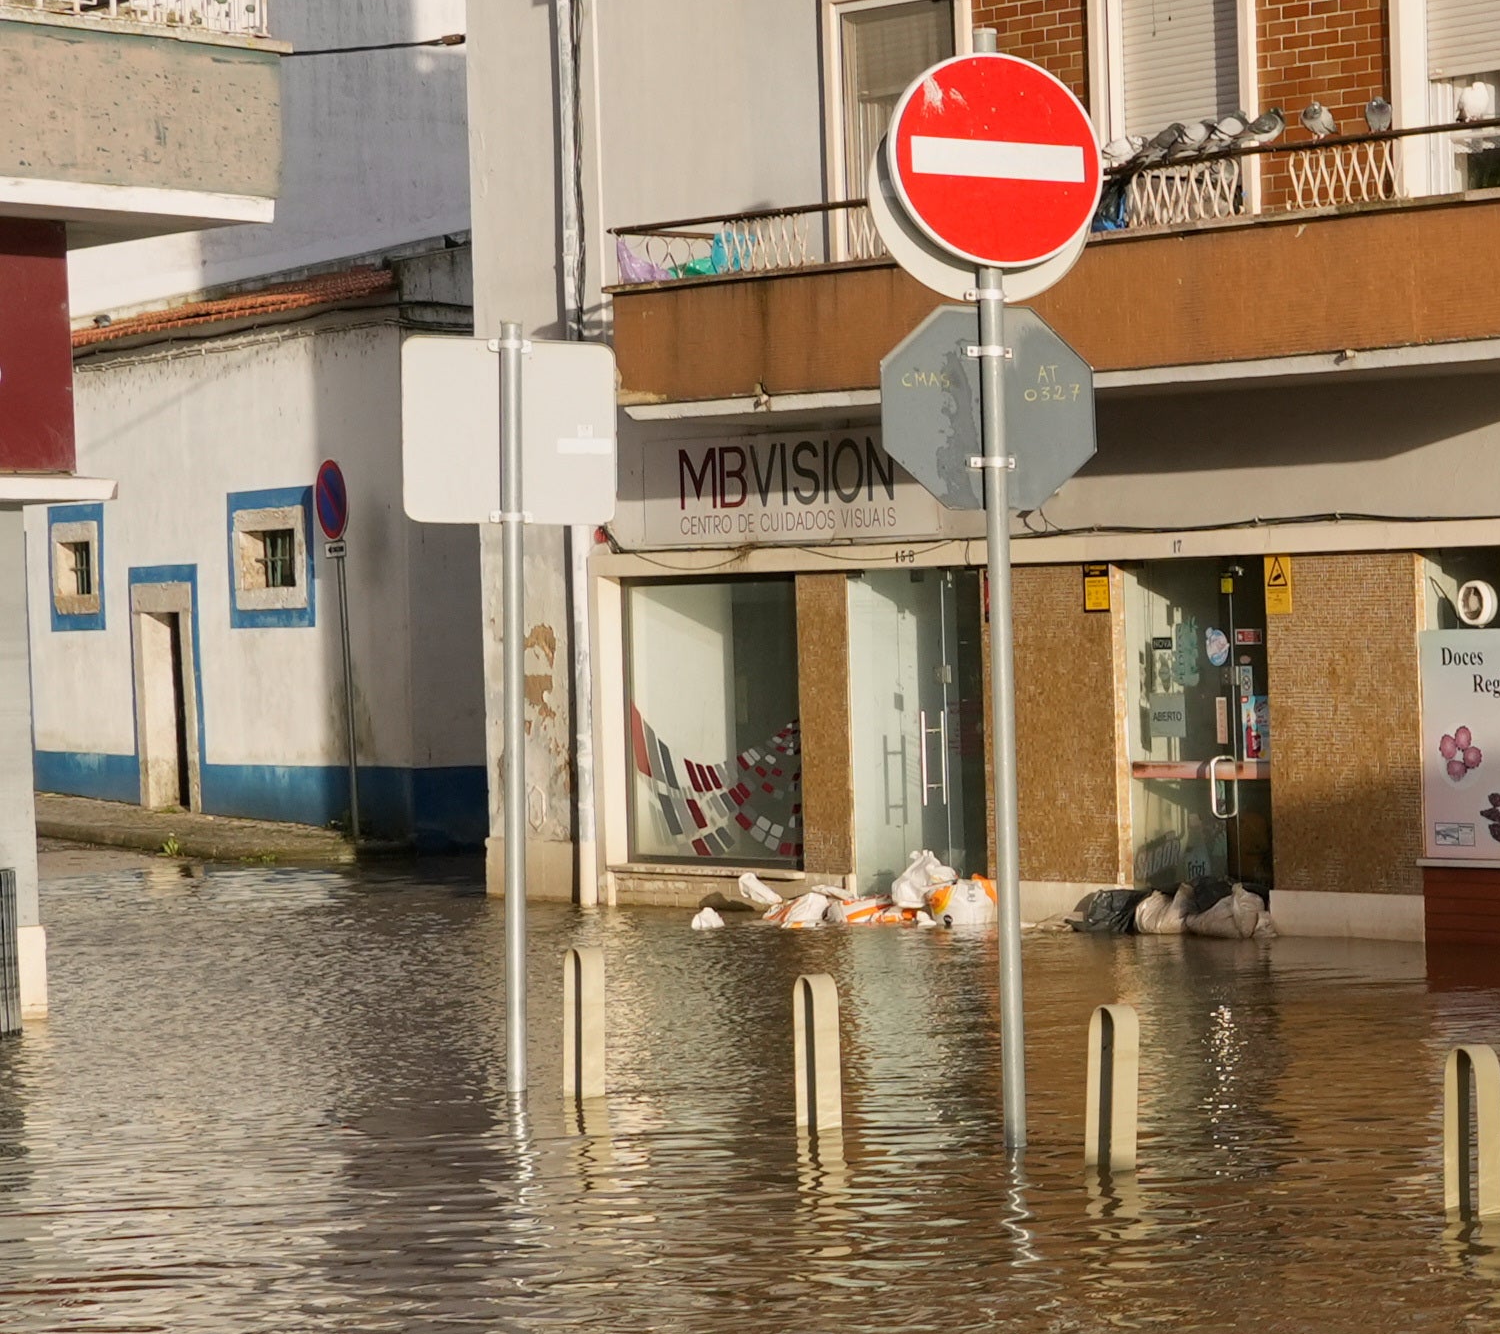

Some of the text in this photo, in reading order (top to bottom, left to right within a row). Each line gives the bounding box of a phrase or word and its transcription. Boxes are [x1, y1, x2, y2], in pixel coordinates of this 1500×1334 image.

[901, 371, 952, 388] CMAS
[1037, 366, 1058, 383] AT
[680, 506, 897, 536] CENTRO DE CUIDADOS VISUAIS
[1173, 540, 1182, 553] 17
[1153, 639, 1172, 649] NOVA
[1441, 647, 1484, 666] Doces
[1152, 711, 1182, 723] ABERTO
